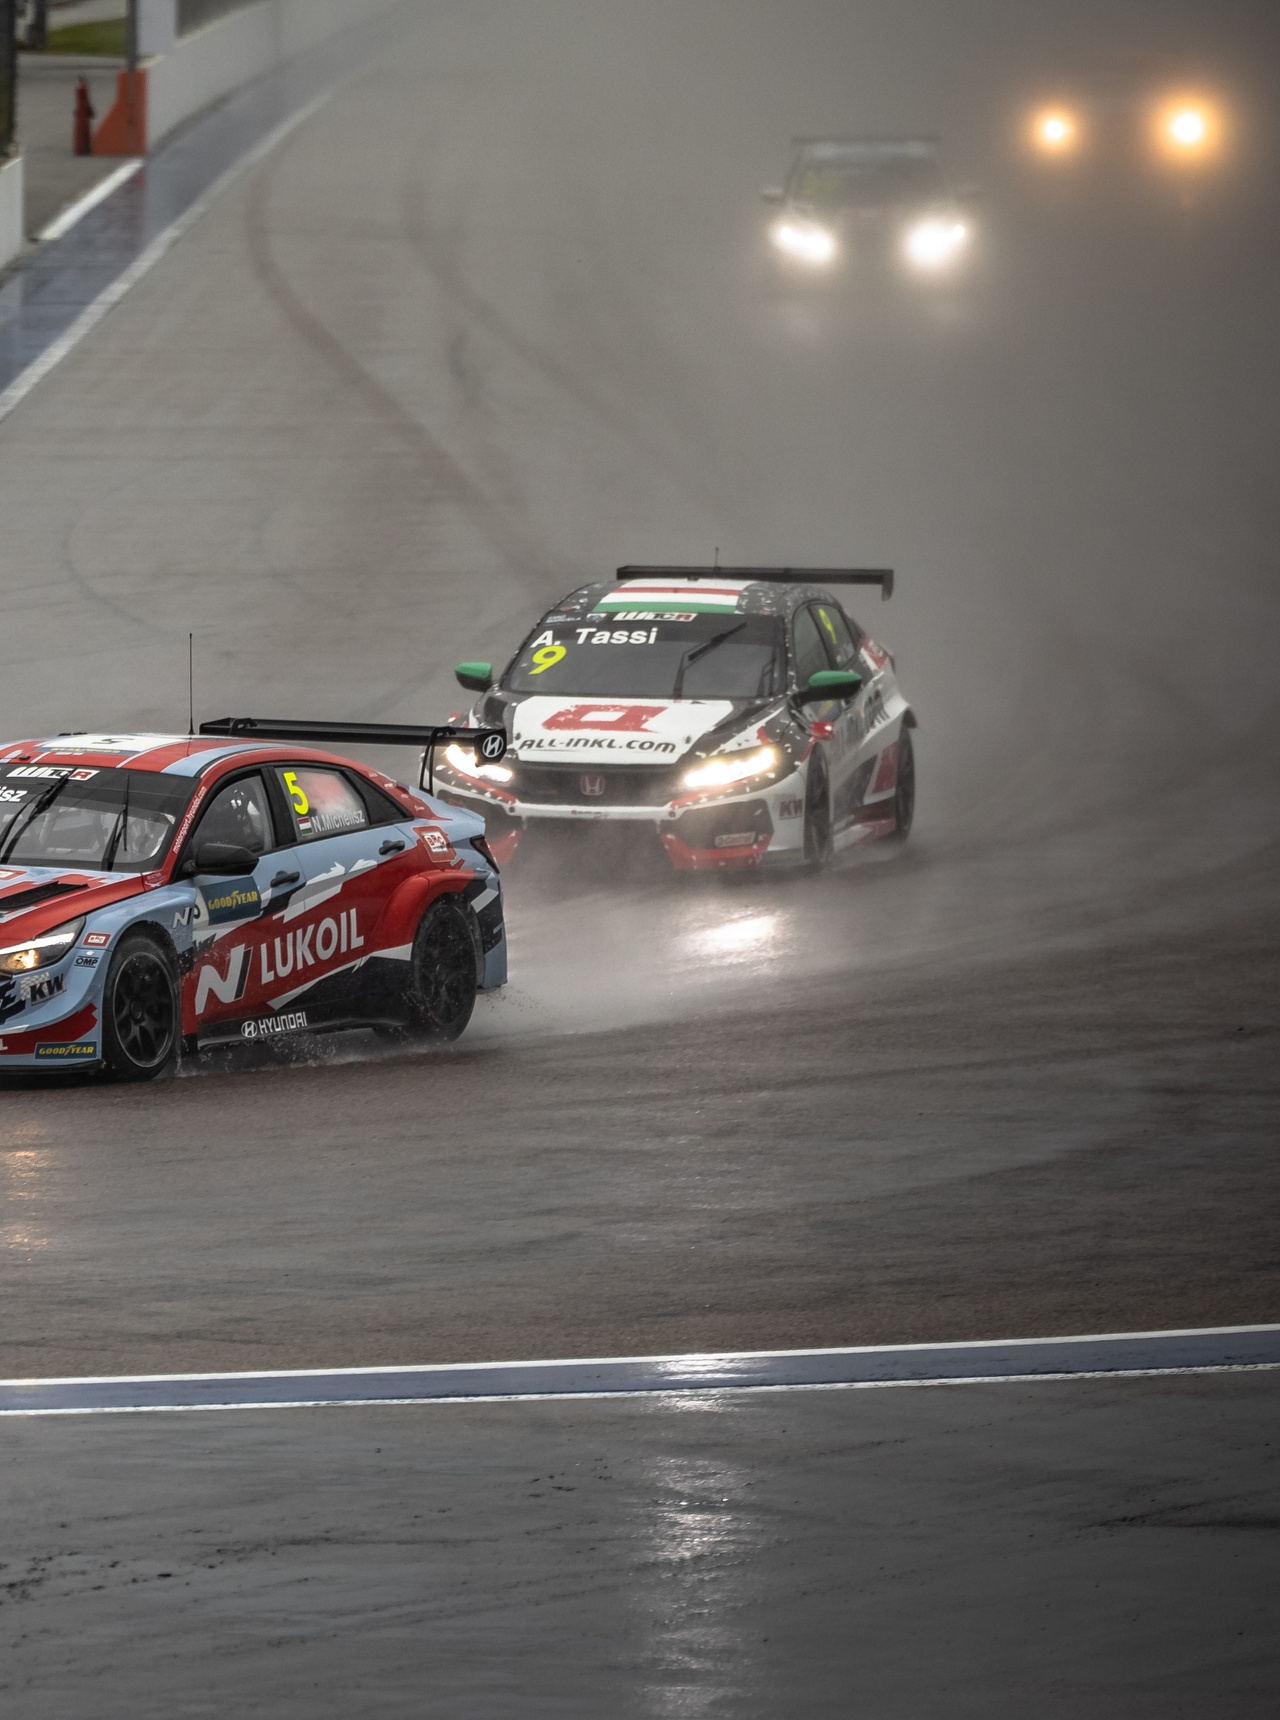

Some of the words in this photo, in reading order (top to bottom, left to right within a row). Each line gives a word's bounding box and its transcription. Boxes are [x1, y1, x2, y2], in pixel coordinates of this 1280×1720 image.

[530, 630, 562, 648] A.
[575, 627, 658, 645] Tassi
[528, 645, 567, 675] 9
[283, 771, 309, 815] 5
[172, 785, 207, 854] motorsport.hyundai.com
[208, 890, 258, 911] GOODYEAR
[261, 907, 364, 985] LUKOIL
[75, 957, 98, 967] OMP
[30, 972, 65, 1002] KW
[258, 1011, 308, 1035] HYUNDAI
[39, 1043, 95, 1056] GOODYEAR
